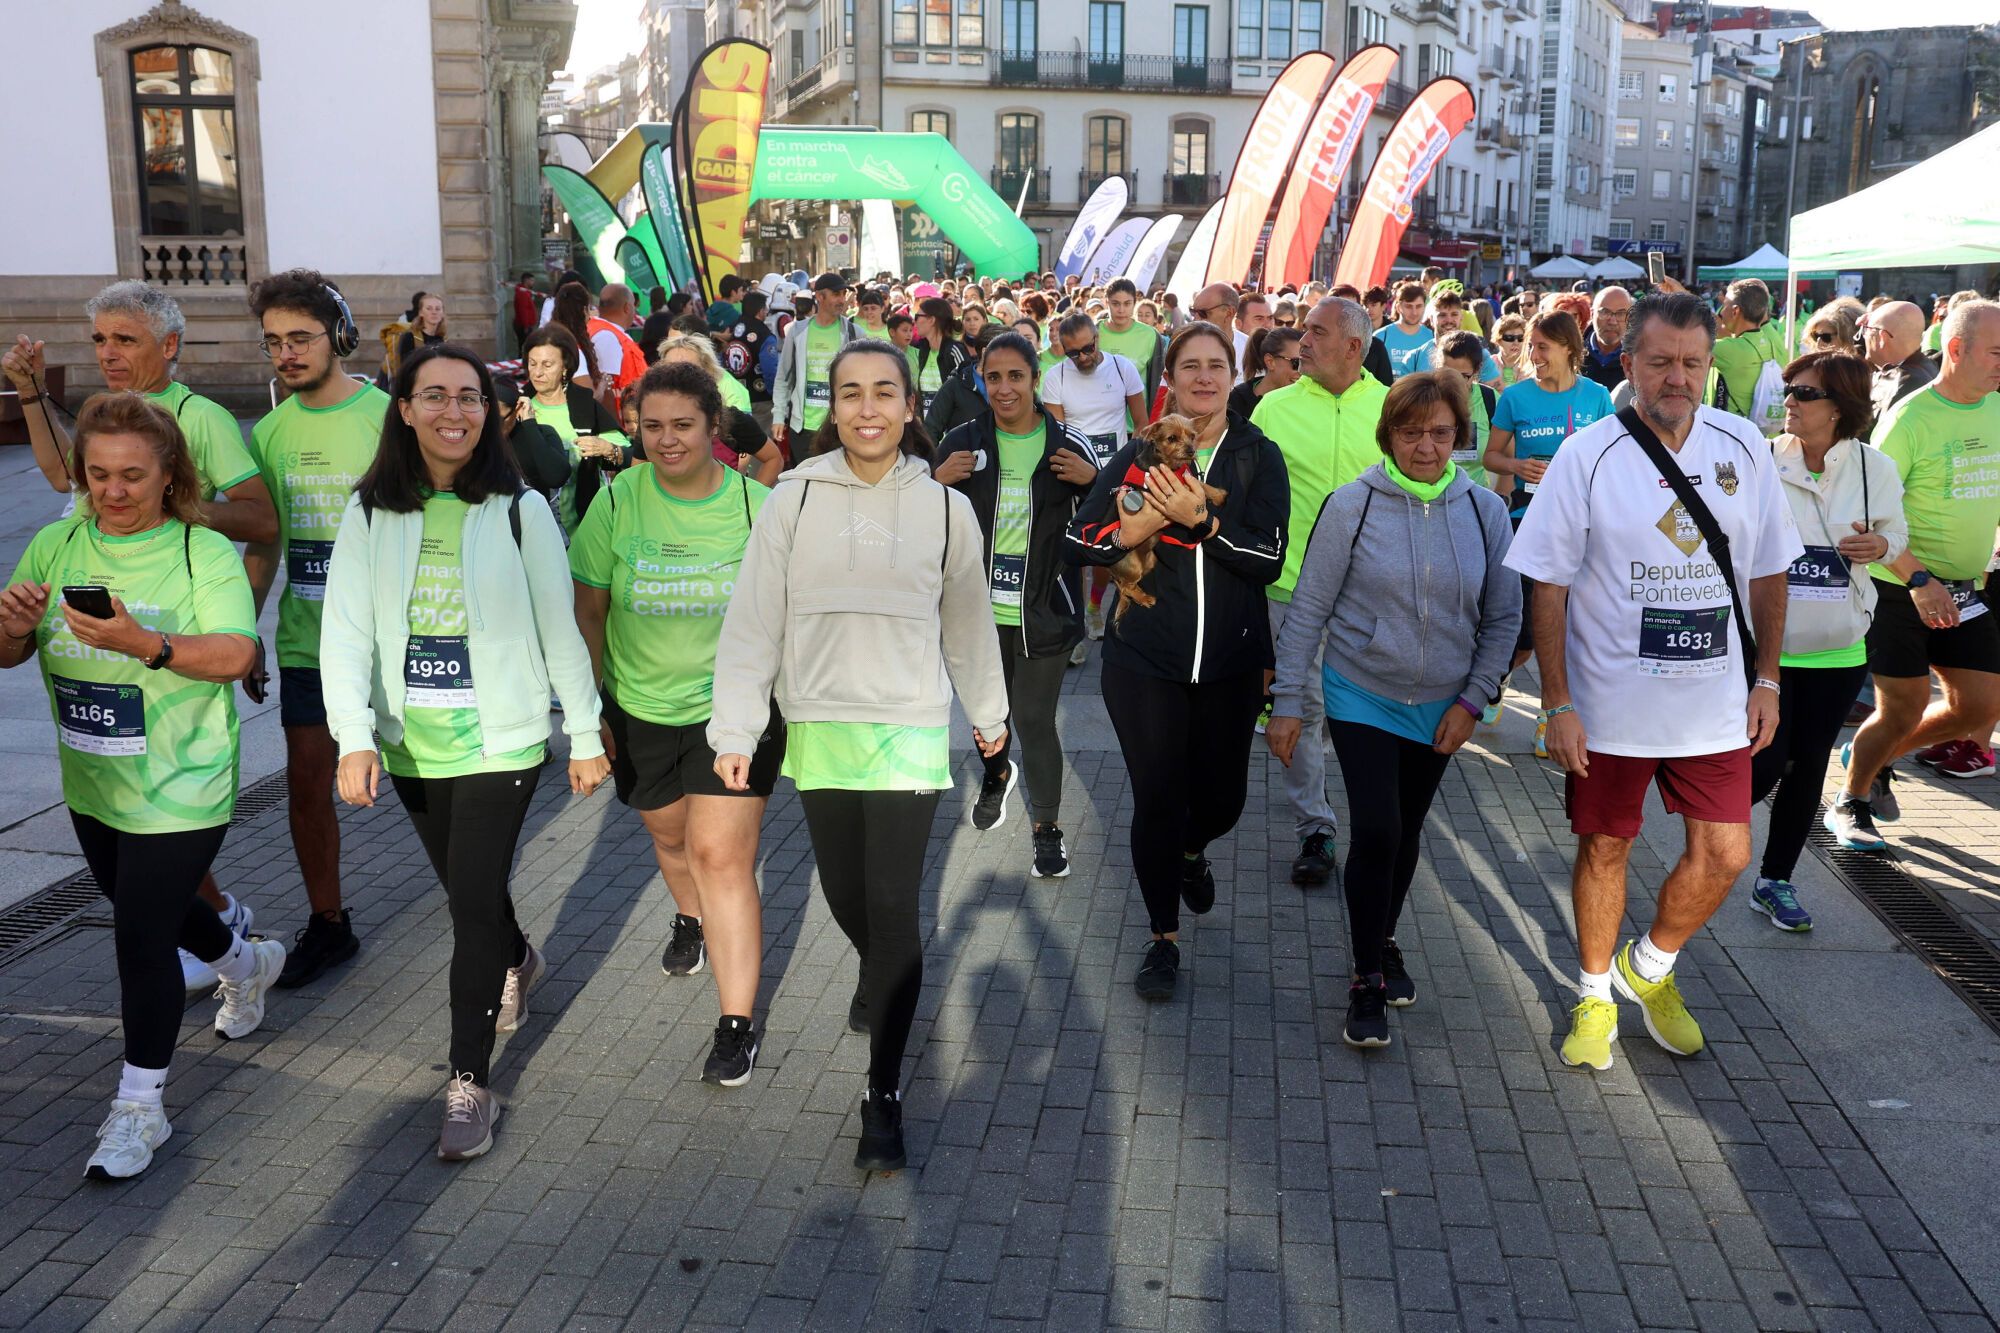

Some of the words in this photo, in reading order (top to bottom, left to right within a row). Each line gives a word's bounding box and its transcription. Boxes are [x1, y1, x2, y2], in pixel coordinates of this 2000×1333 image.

[1240, 89, 1298, 187] FROIZ
[1302, 84, 1363, 183] FROIZ
[766, 140, 785, 152] En
[790, 140, 846, 152] marcha
[768, 156, 817, 167] contra
[1371, 104, 1440, 213] FROIZ
[699, 162, 750, 179] GADIS
[768, 171, 782, 182] el
[785, 170, 838, 183] cáncer
[1534, 416, 1548, 424] vie
[1521, 427, 1554, 438] CLOUD
[1953, 457, 1968, 467] En
[1954, 468, 1998, 484] contra
[636, 560, 659, 573] En
[665, 561, 732, 574] marcha
[1789, 562, 1830, 578] 1634
[993, 568, 1020, 584] 615
[633, 579, 714, 596] contra
[721, 581, 735, 596] o
[1645, 610, 1684, 618] Pontevedra
[1666, 631, 1712, 650] 1633
[410, 660, 460, 677] 1920
[70, 704, 116, 726] 1165
